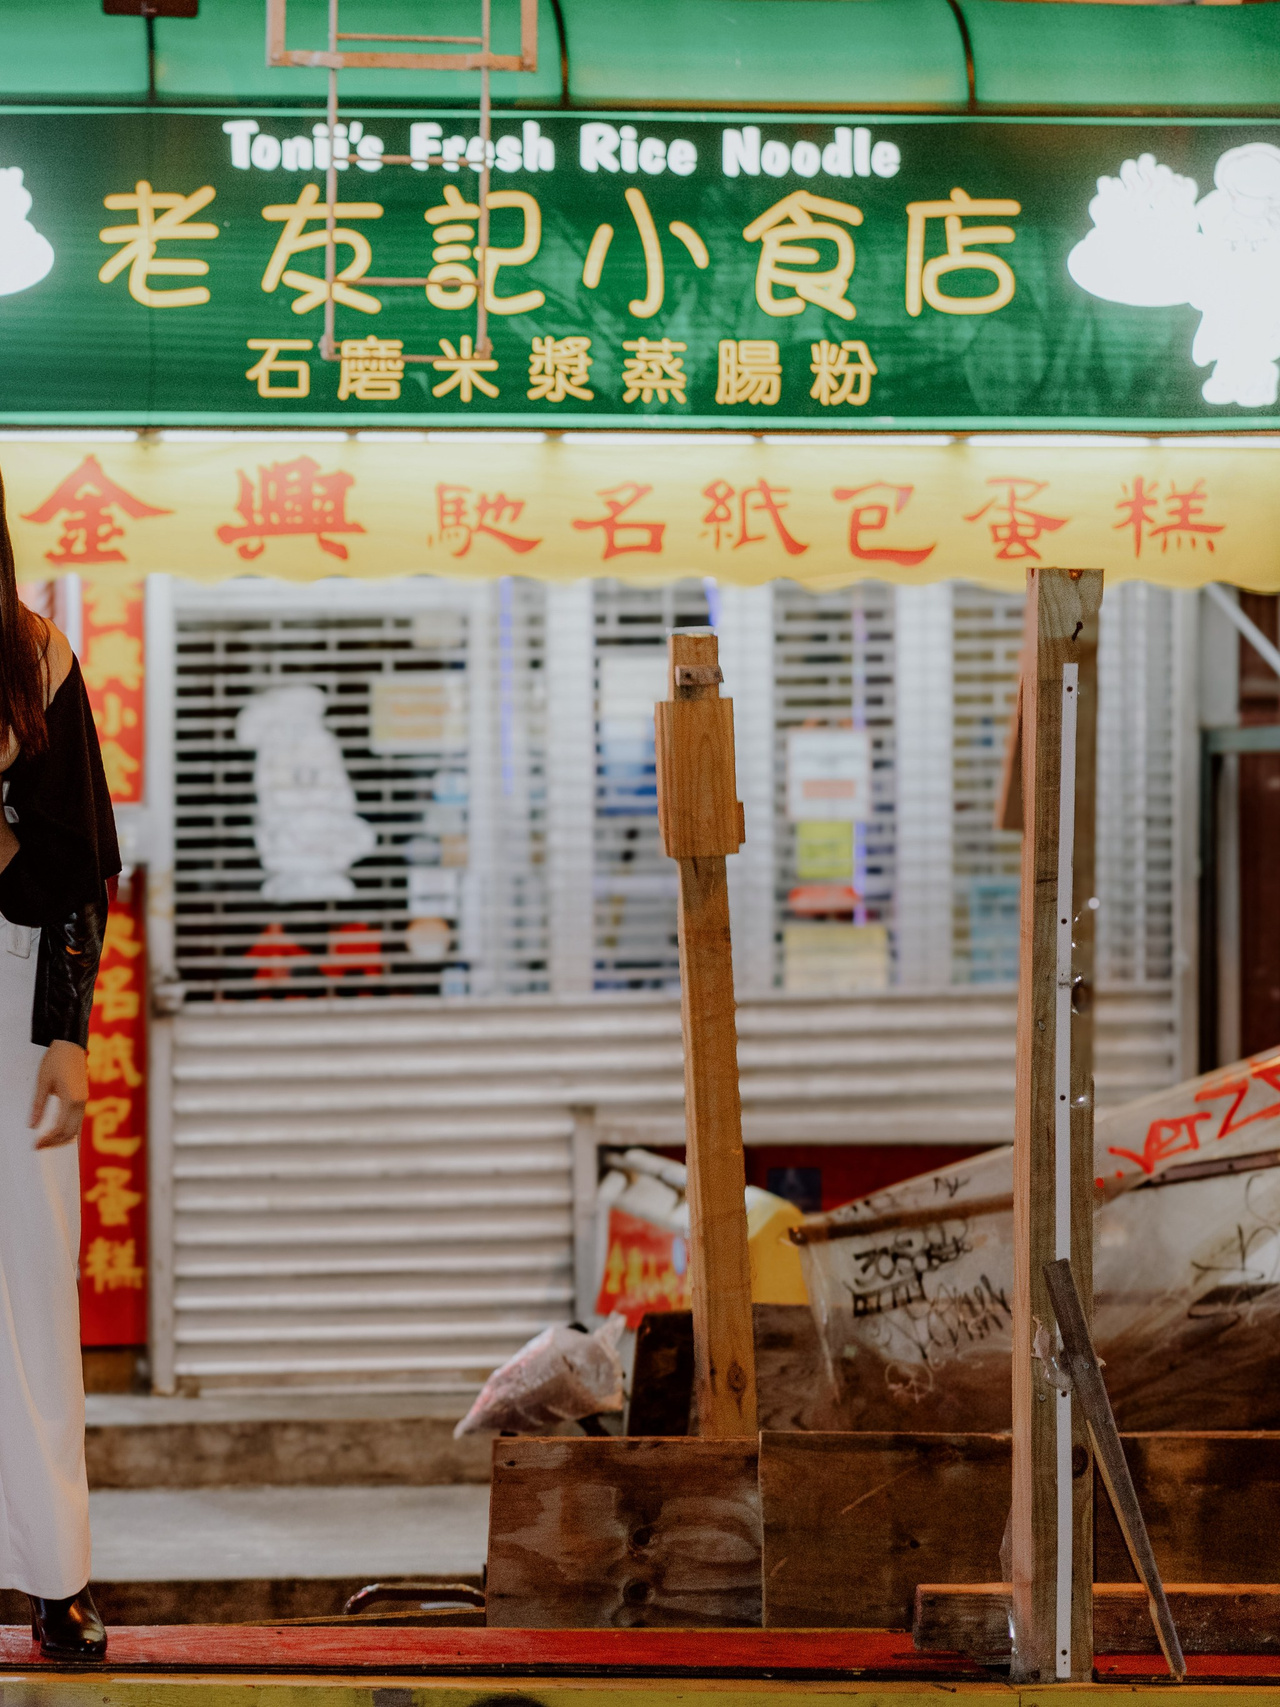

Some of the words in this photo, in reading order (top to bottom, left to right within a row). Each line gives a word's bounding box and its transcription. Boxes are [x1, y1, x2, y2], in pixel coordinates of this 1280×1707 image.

[221, 119, 385, 173] Tonii's
[410, 119, 556, 173] Fresh
[579, 122, 698, 176] Rice
[722, 125, 902, 179] Noodle
[98, 179, 1021, 321] 老友記小食店
[245, 335, 878, 406] 石磨米漿蒸腸粉
